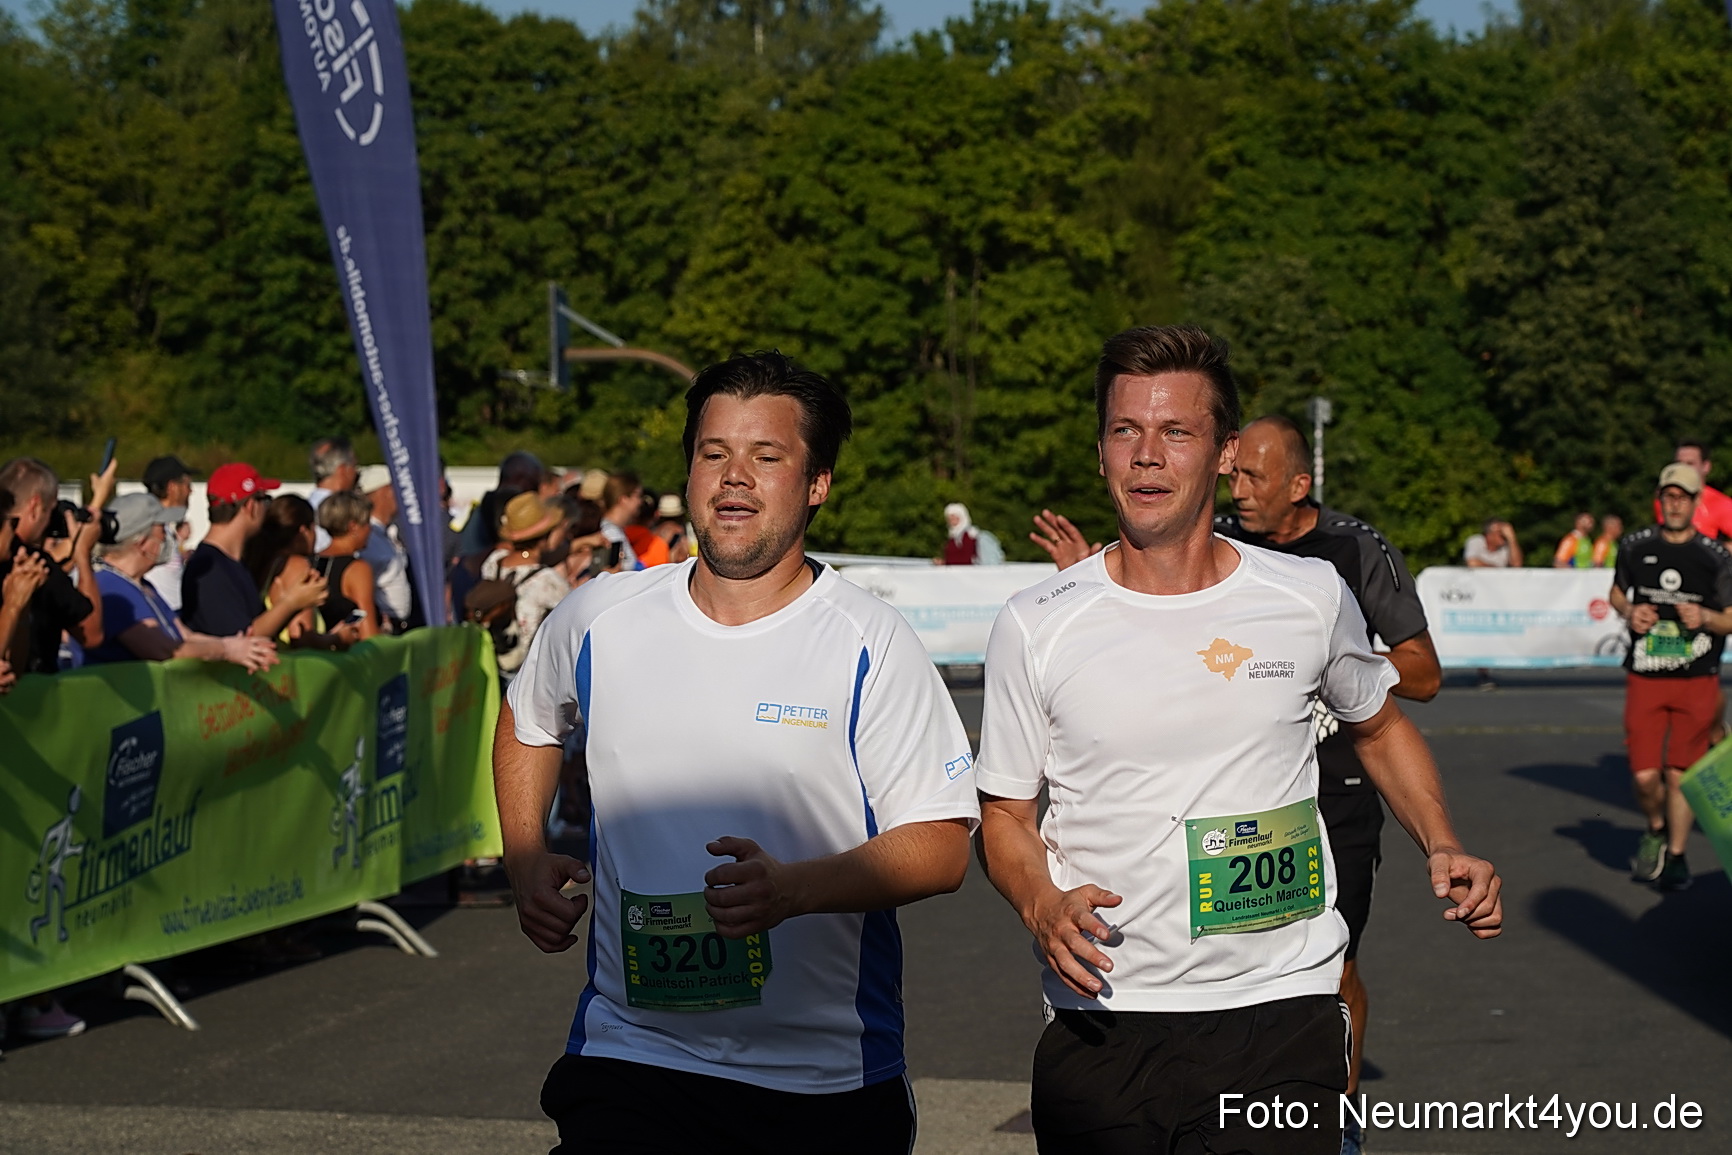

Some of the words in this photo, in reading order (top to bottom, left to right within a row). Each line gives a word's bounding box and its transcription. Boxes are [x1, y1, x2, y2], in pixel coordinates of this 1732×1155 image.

[1050, 581, 1077, 599] JAKO
[1215, 653, 1235, 665] NM
[1248, 661, 1295, 671] LANDKREIS
[1248, 669, 1295, 680] NEUMARKT
[783, 705, 829, 720] PETTER
[781, 717, 828, 729] INGENIEURE
[77, 787, 203, 903] firmenlauf
[1228, 830, 1273, 848] Firmenlauf
[1246, 838, 1273, 850] neumarkt
[1228, 846, 1296, 895] 208
[1307, 845, 1320, 899] 2022
[1199, 872, 1213, 913] RUN
[1276, 886, 1309, 903] Marco
[1213, 893, 1273, 913] Queitsch
[645, 914, 692, 926] Firmenlauf
[662, 922, 692, 931] neumarkt
[648, 932, 727, 973] 320
[746, 932, 765, 988] 2022
[627, 945, 641, 985] RUN
[640, 975, 695, 990] Queitsch
[699, 971, 750, 988] Patrick
